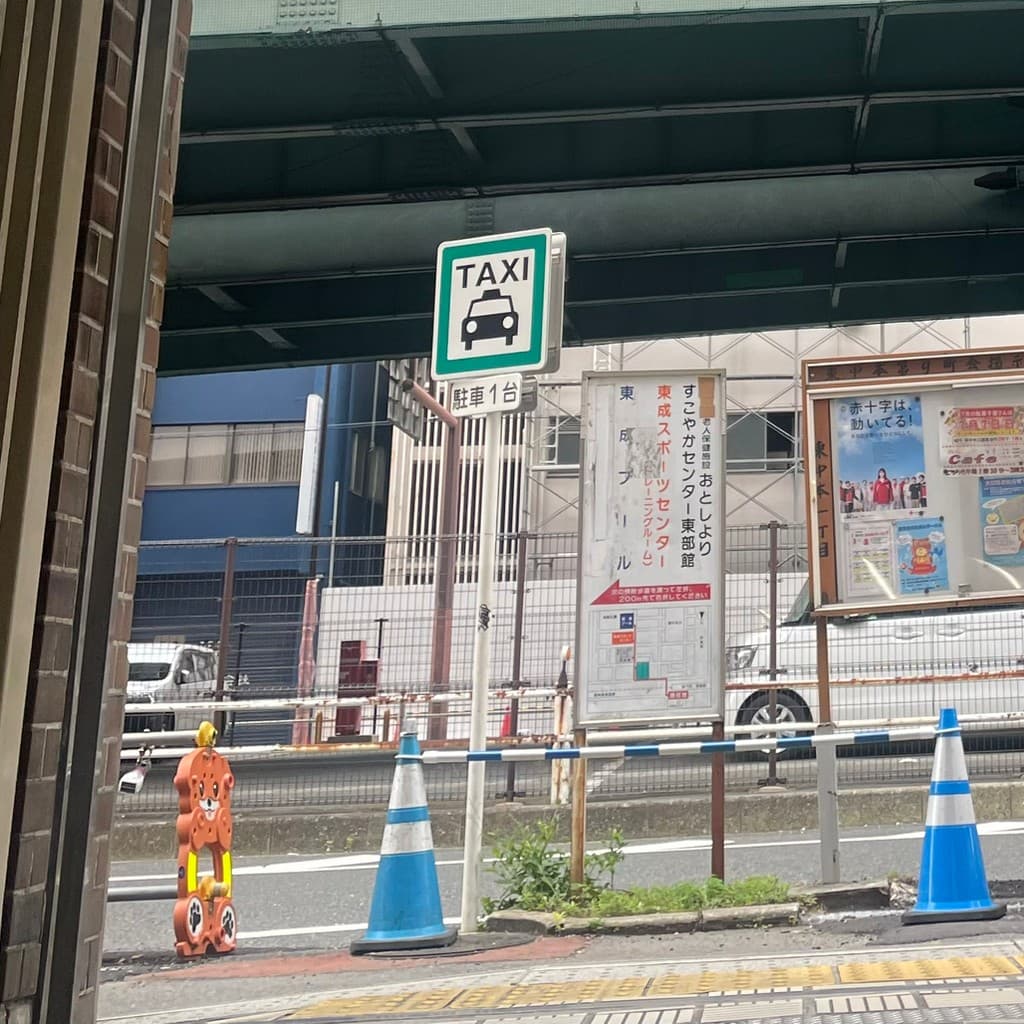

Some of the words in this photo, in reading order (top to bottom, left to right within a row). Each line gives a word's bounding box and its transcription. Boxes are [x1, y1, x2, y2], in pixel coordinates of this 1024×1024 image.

[455, 256, 530, 289] TAXI
[453, 381, 518, 410] 駐車1台
[655, 384, 673, 568] 東成スポーツセンター
[680, 383, 697, 569] すこやかセンター東部館
[698, 473, 713, 557] おとしより
